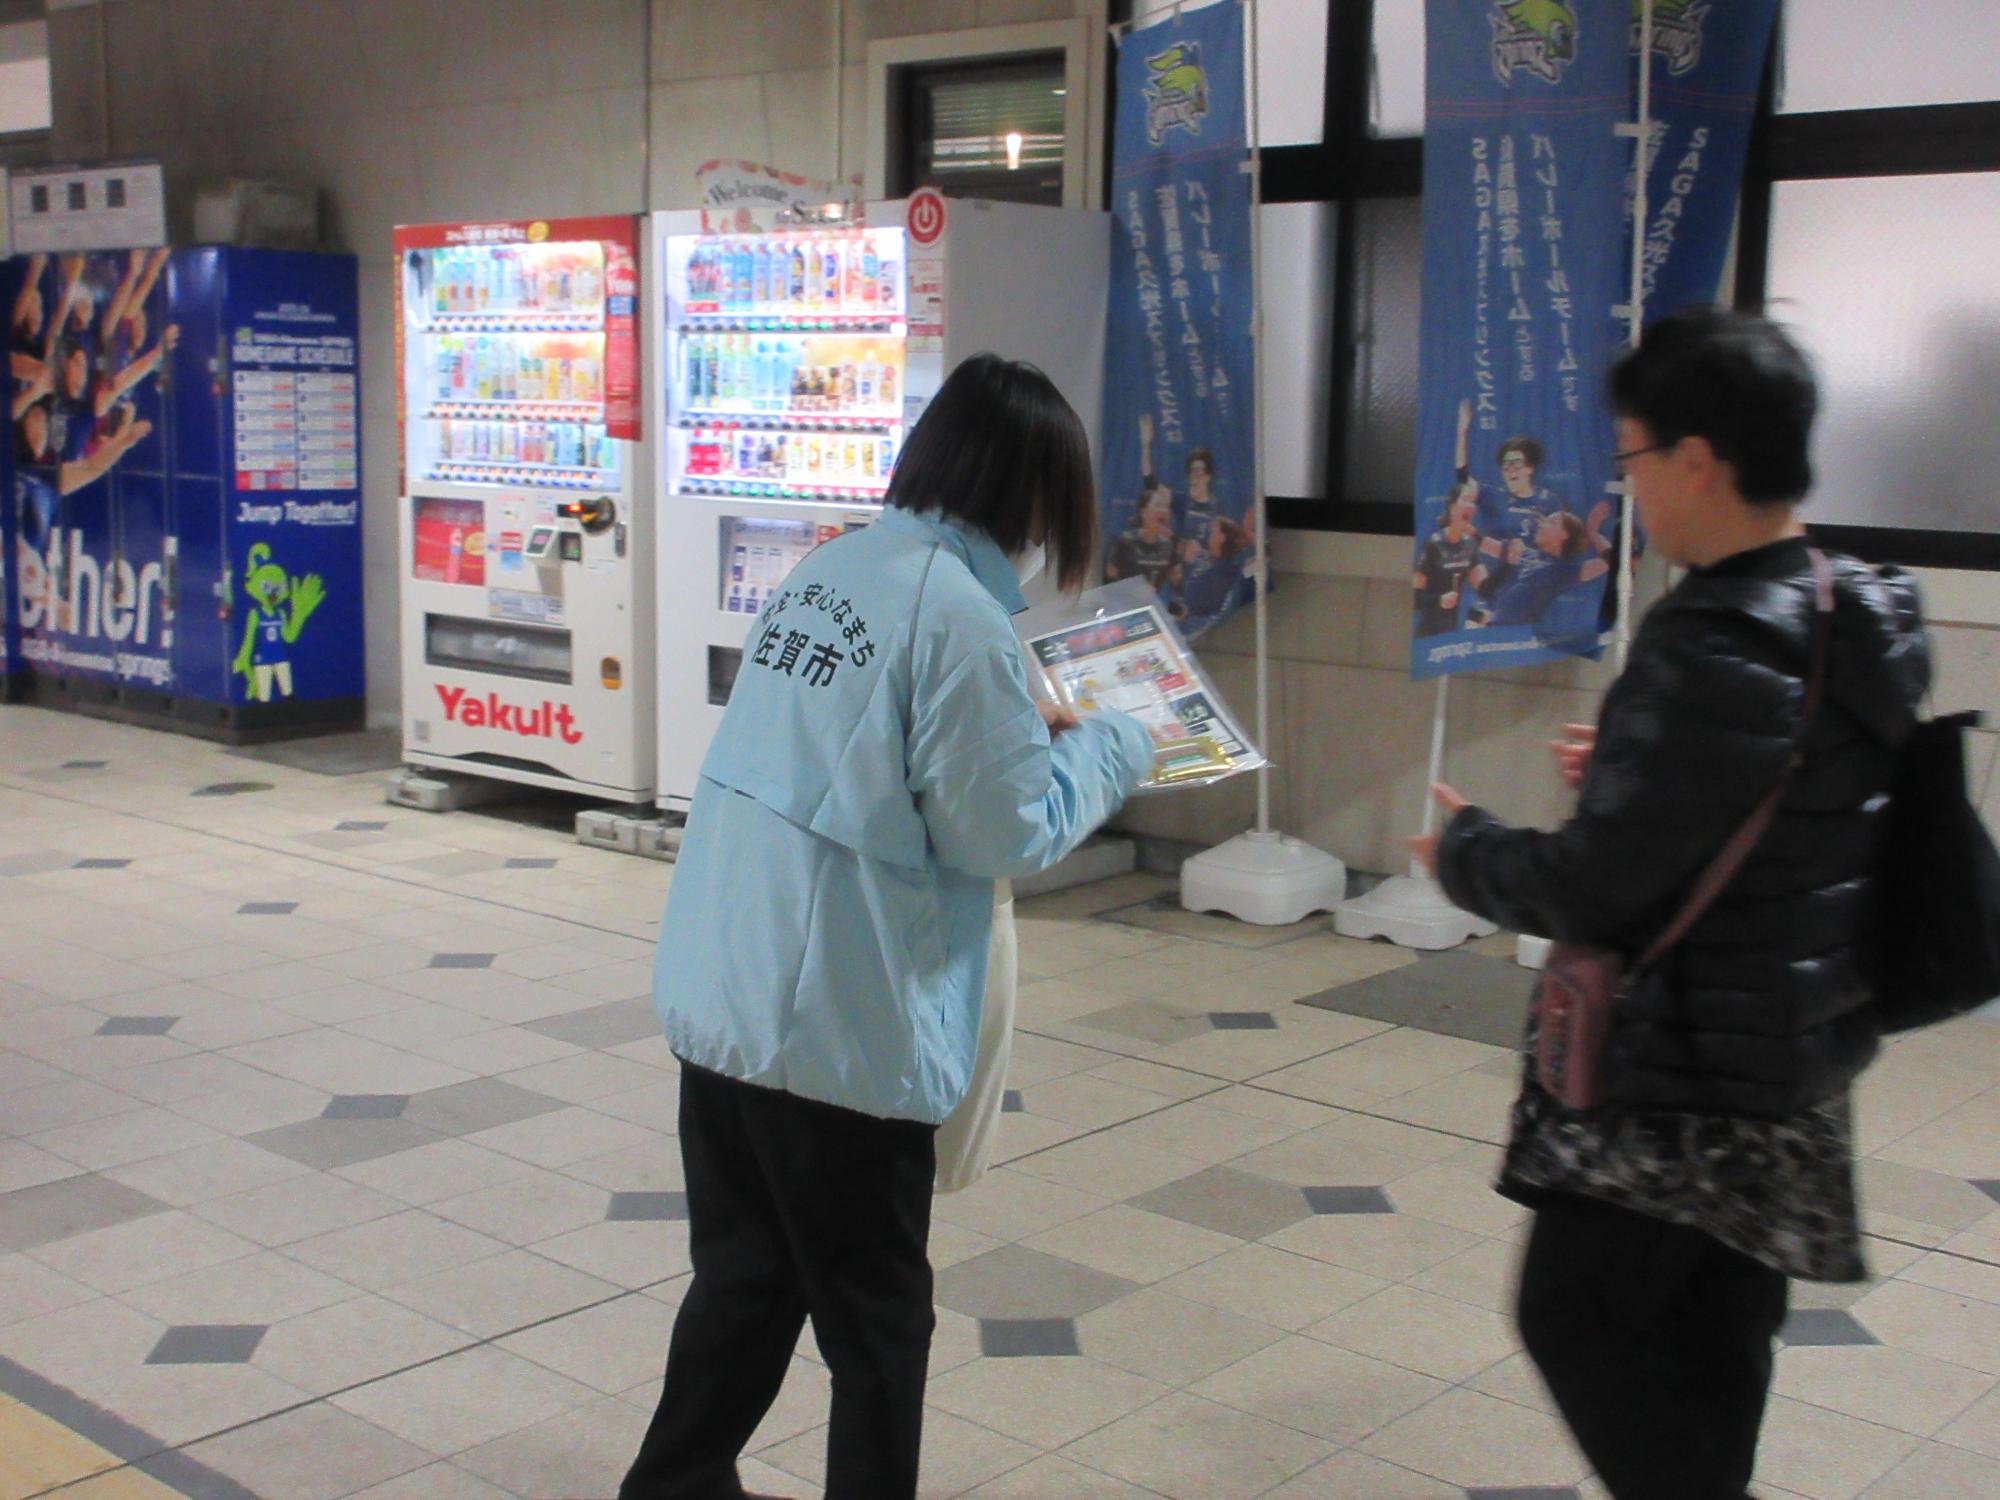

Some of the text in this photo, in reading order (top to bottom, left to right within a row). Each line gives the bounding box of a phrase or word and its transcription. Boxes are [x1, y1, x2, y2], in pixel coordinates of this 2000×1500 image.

[751, 621, 845, 688] 佐賀市
[434, 684, 584, 745] Yakult
